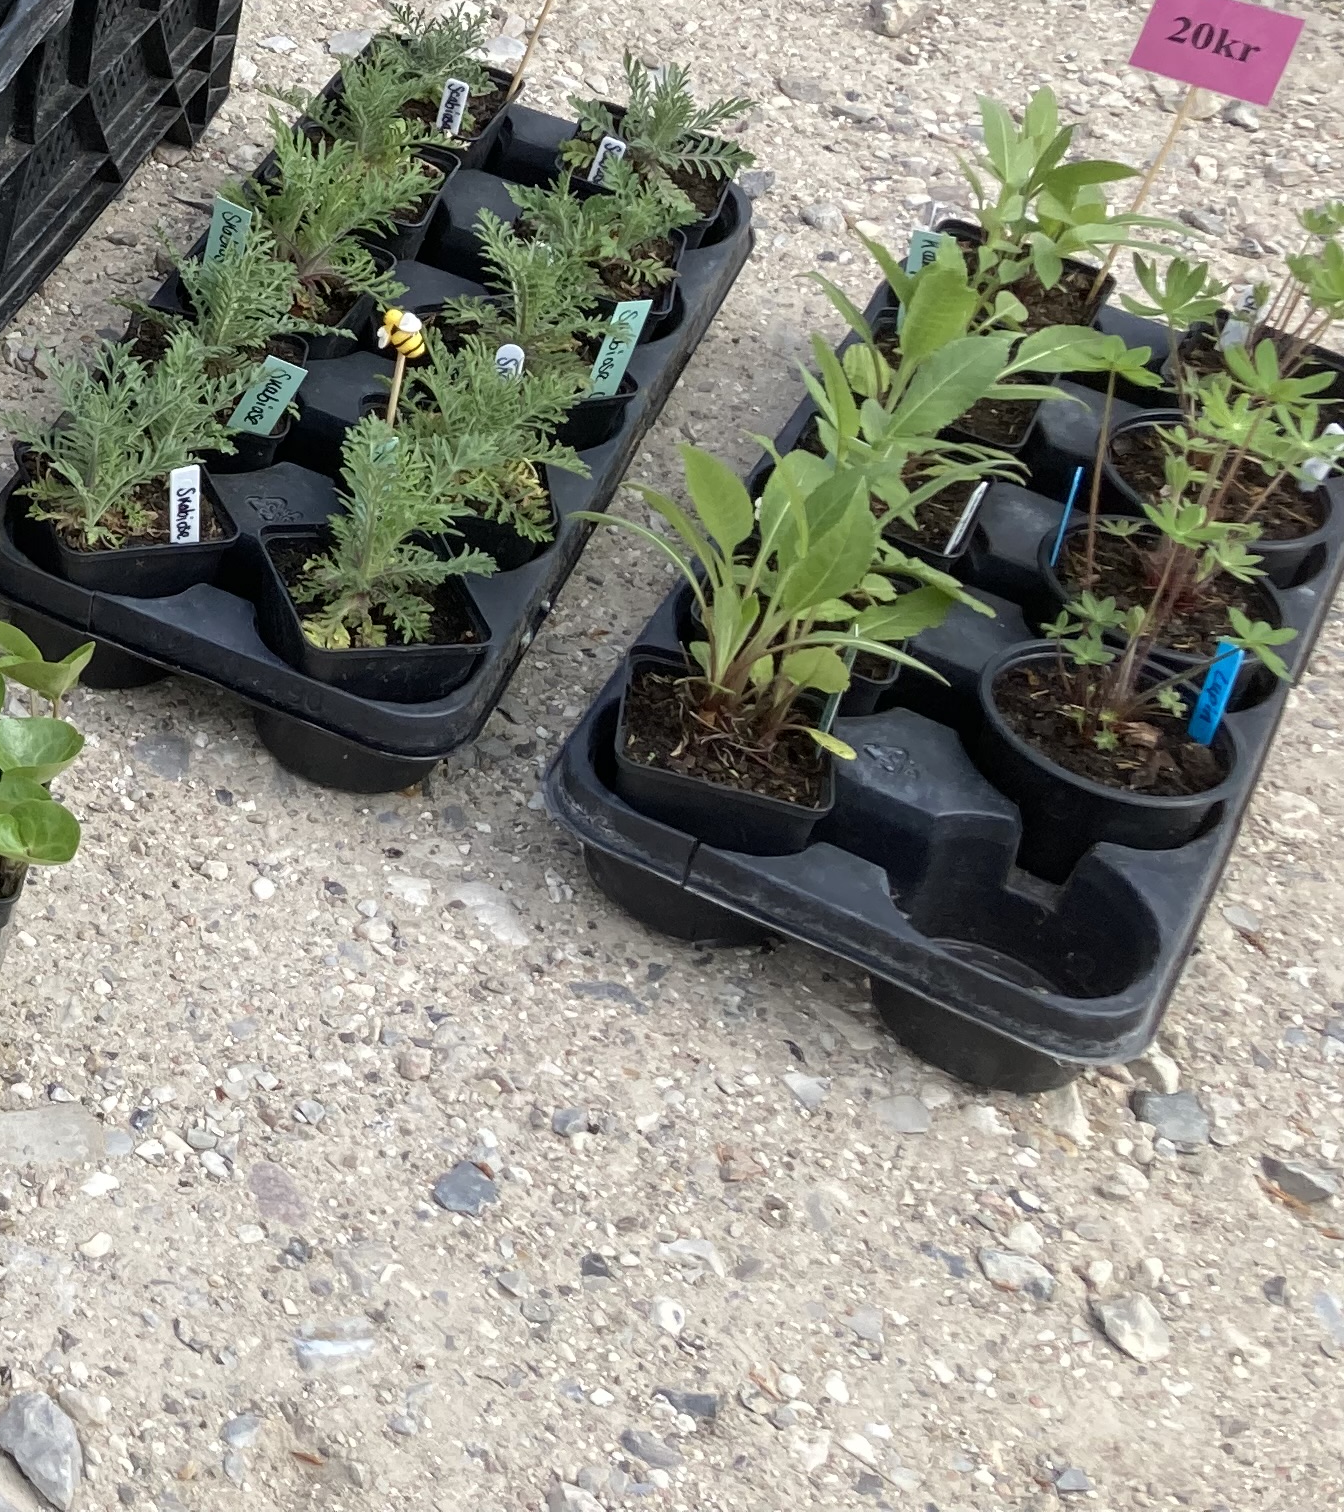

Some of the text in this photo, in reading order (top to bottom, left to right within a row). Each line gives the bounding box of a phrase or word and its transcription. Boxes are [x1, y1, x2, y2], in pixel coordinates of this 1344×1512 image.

[1166, 16, 1261, 62] 20kr
[596, 305, 637, 385] Skbiose
[244, 370, 290, 424] Skabiose
[176, 487, 195, 539] Skabiose
[1199, 669, 1226, 723] Lupin
